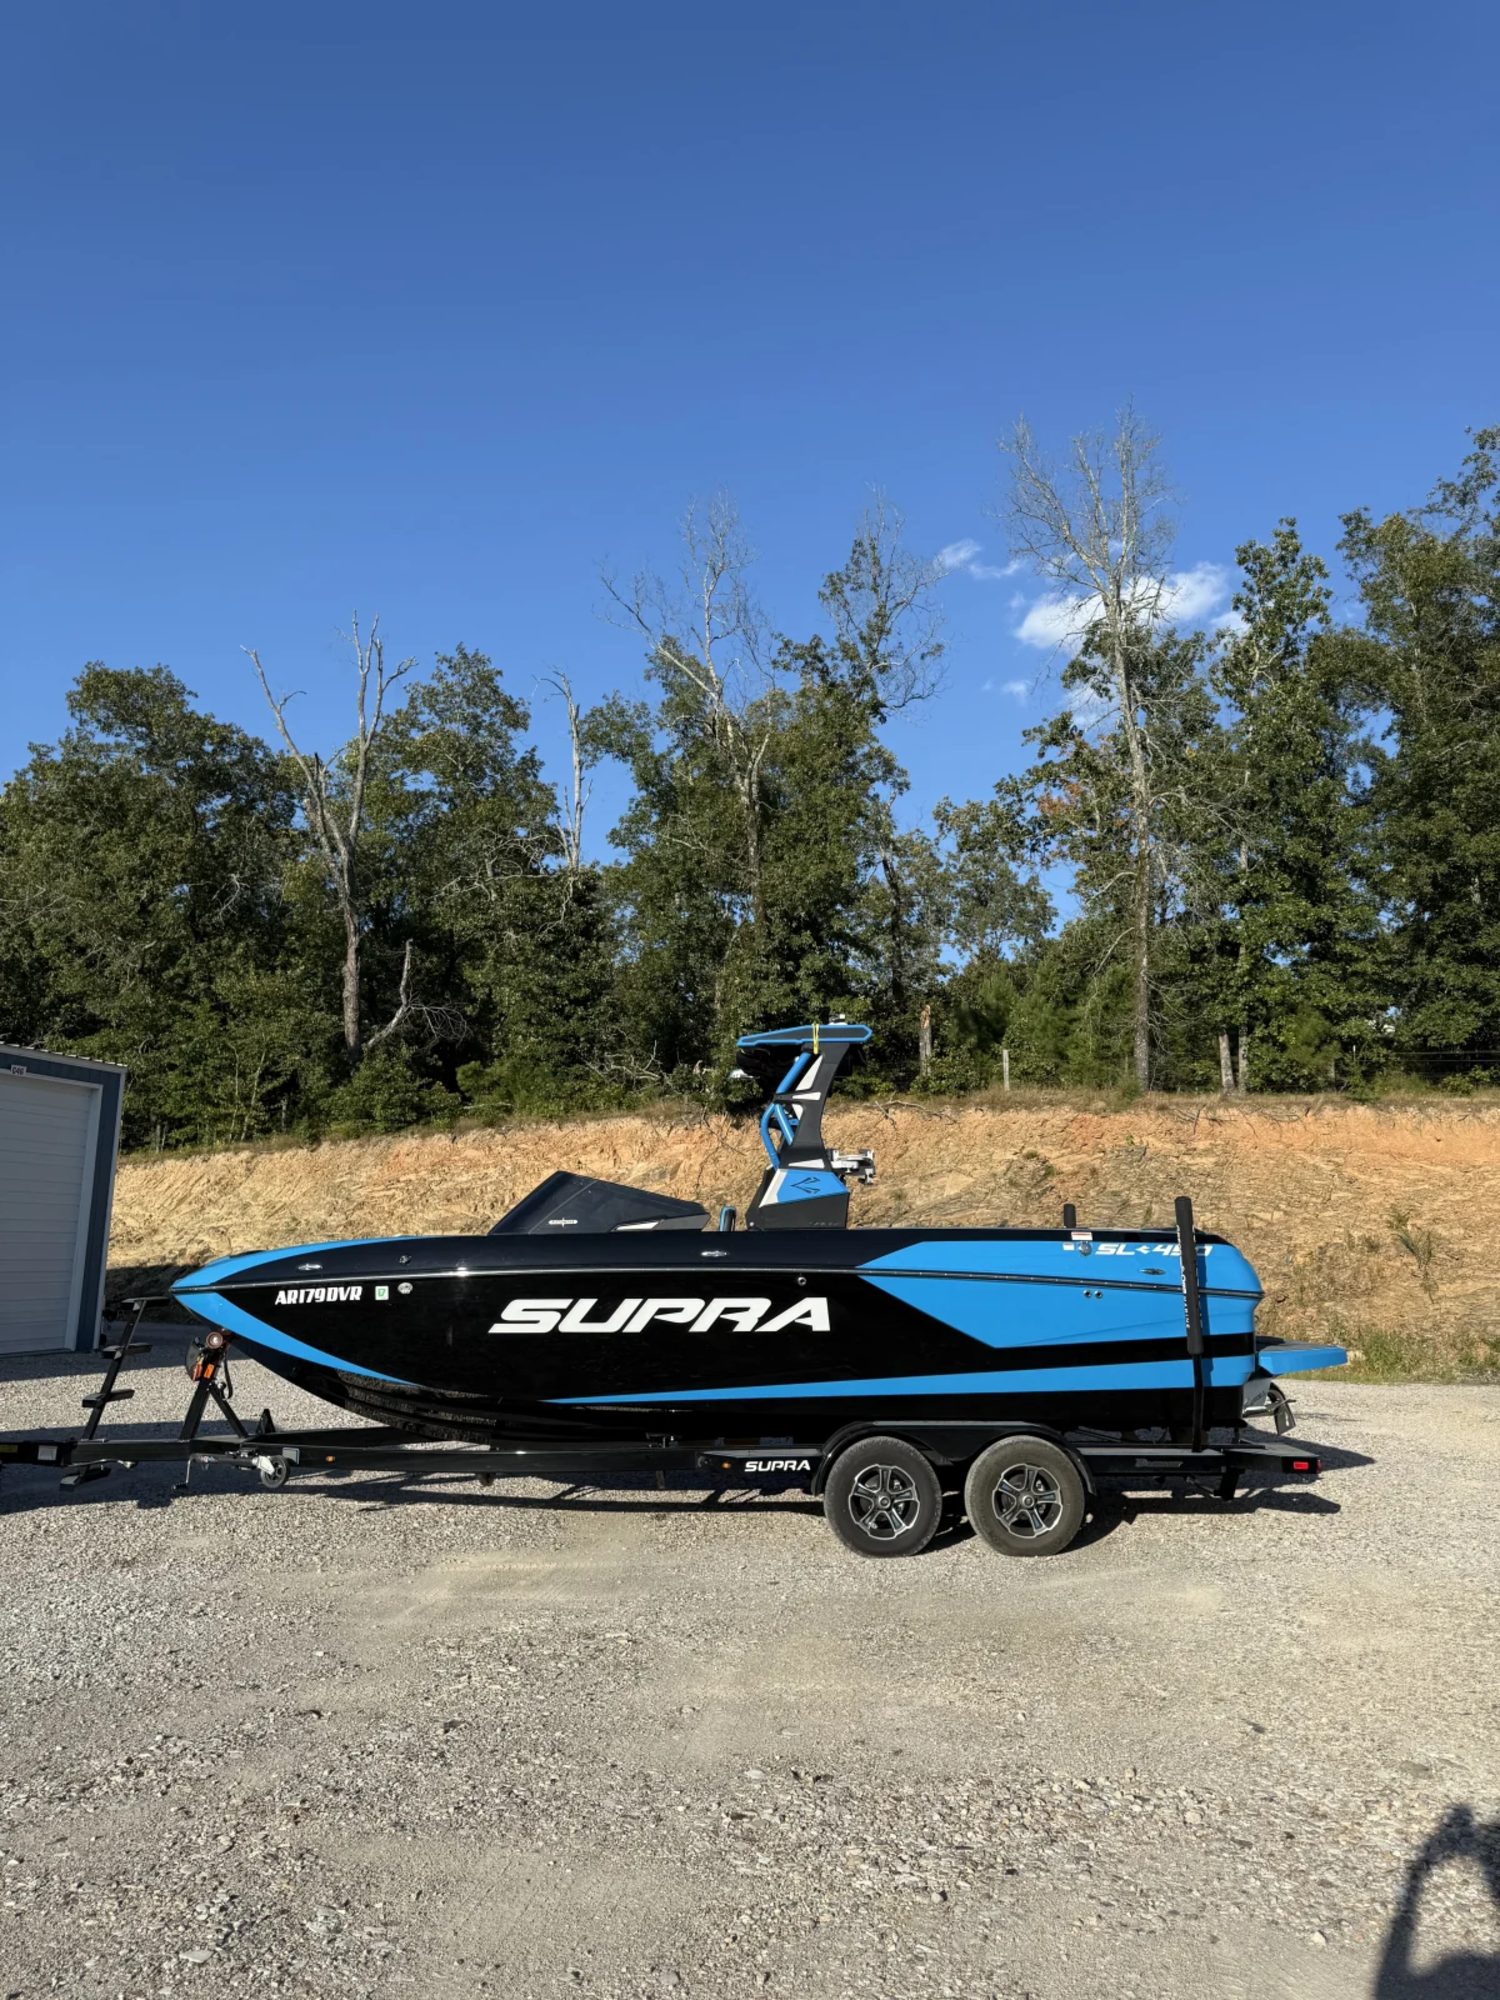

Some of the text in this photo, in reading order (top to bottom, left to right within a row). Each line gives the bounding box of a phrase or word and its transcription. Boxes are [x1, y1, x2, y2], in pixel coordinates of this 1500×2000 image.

[1095, 1244, 1135, 1256] SL
[488, 1297, 831, 1333] SUPRA
[744, 1460, 811, 1472] SUPRA
